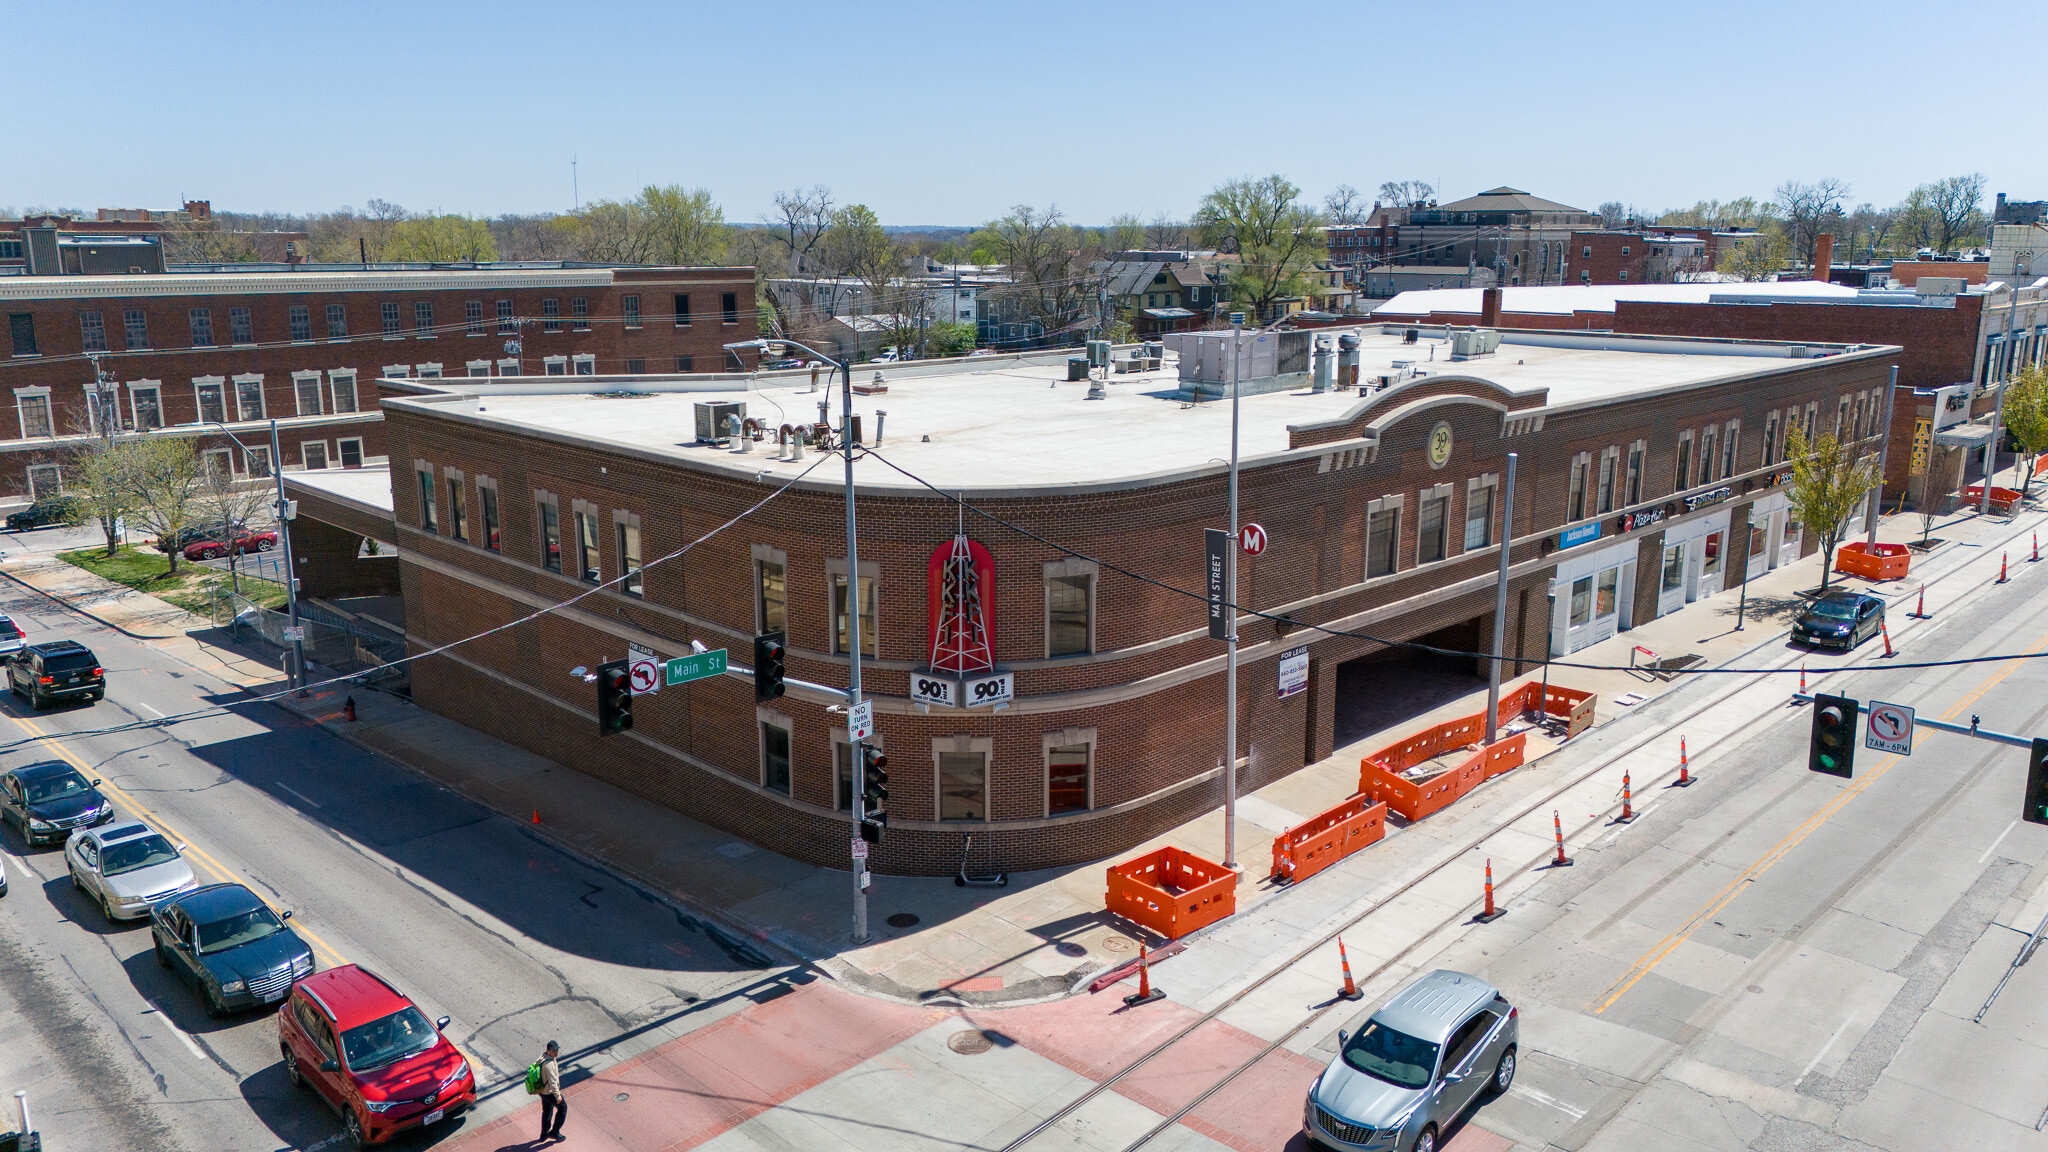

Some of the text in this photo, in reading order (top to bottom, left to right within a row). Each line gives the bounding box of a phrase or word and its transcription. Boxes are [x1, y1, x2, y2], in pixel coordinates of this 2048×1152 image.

[1243, 529, 1260, 552] M
[1567, 529, 1583, 542] Jackson
[1211, 554, 1221, 618] MAN STREET
[629, 642, 654, 656] FOR LEASE
[1281, 645, 1308, 660] FOR LEASE
[674, 657, 720, 678] Main St
[854, 706, 866, 715] NO
[851, 720, 871, 732] ON RED
[853, 714, 868, 724] TURN
[1869, 738, 1885, 748] 7AM
[1891, 743, 1908, 752] 6PM
